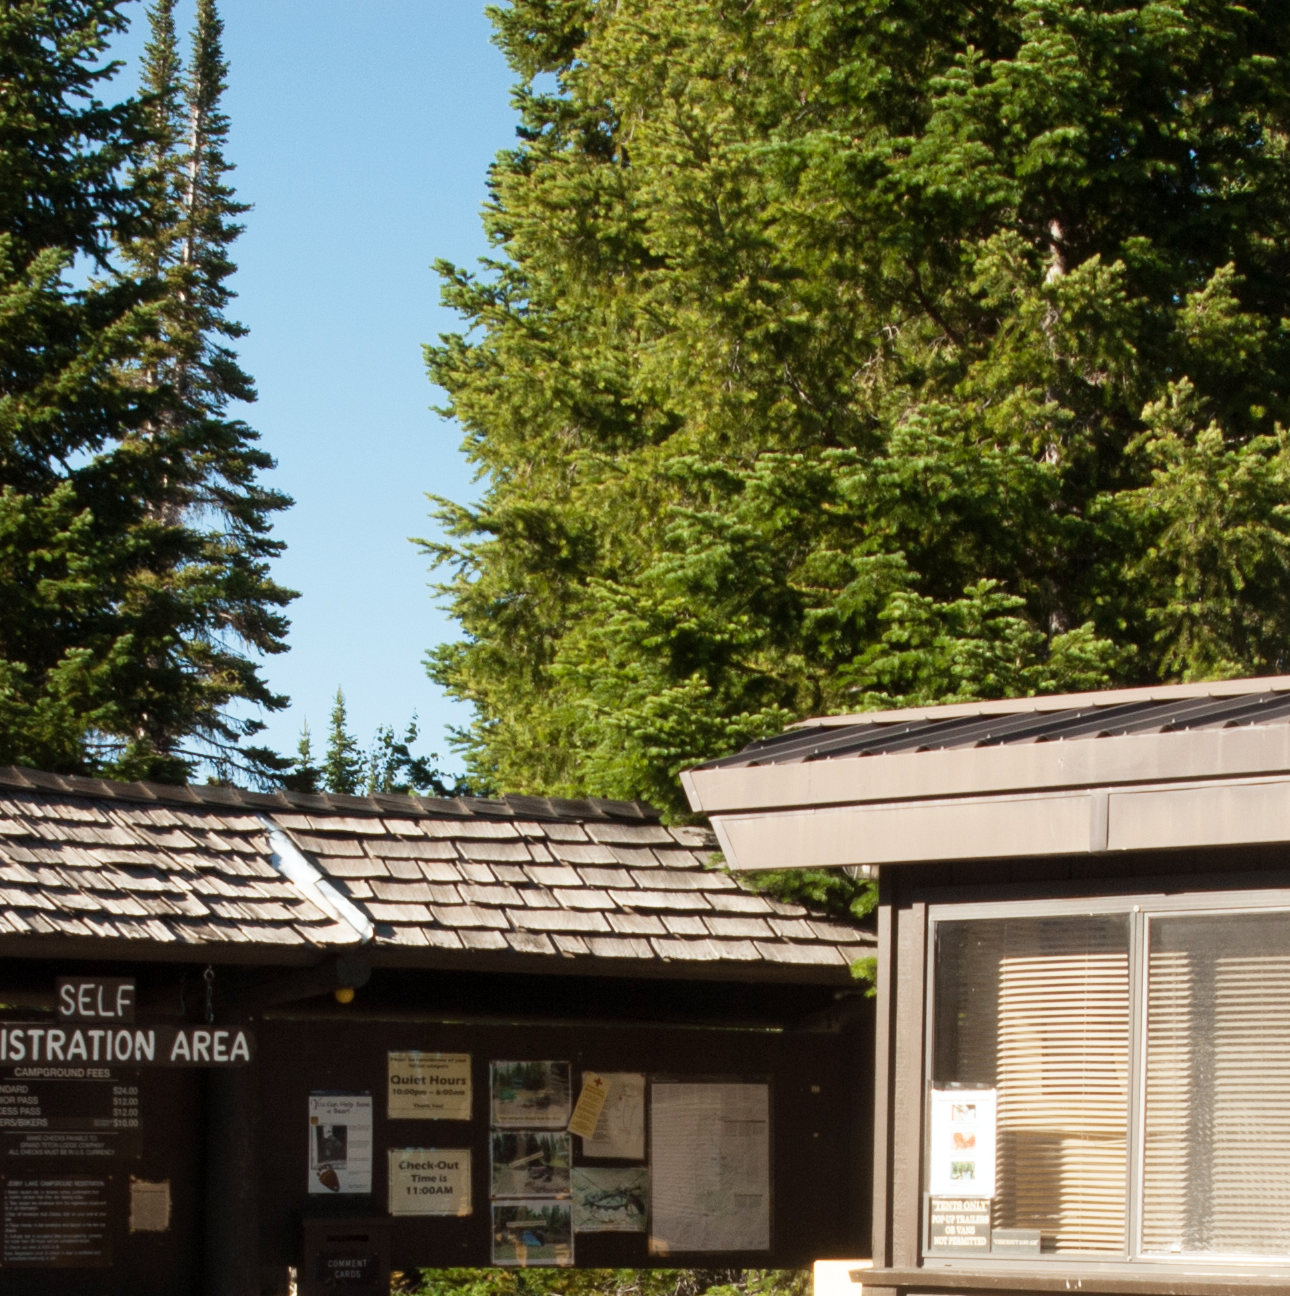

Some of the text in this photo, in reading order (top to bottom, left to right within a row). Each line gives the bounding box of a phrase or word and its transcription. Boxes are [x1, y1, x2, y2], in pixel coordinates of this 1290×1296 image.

[60, 983, 135, 1017] SELF
[171, 1031, 251, 1062] AREA
[14, 1067, 111, 1078] CAMPGROUND FEES
[390, 1075, 467, 1085] Quiet Hours
[113, 1086, 138, 1096] $24.00
[17, 1096, 39, 1105] PASS
[113, 1097, 138, 1106] $12.00
[20, 1107, 42, 1116] PASS
[113, 1108, 138, 1117] $12.00
[113, 1118, 139, 1127] $10.00
[399, 1161, 459, 1170] Check-Out
[411, 1174, 448, 1183] Time is
[406, 1186, 453, 1195] 11:00AM
[932, 1214, 989, 1224] POP-UP TRAILERS
[945, 1225, 975, 1235] OR VANS
[933, 1236, 987, 1246] NOT PERMITTED
[328, 1259, 367, 1268] COMMENT
[335, 1270, 361, 1279] CARDS
